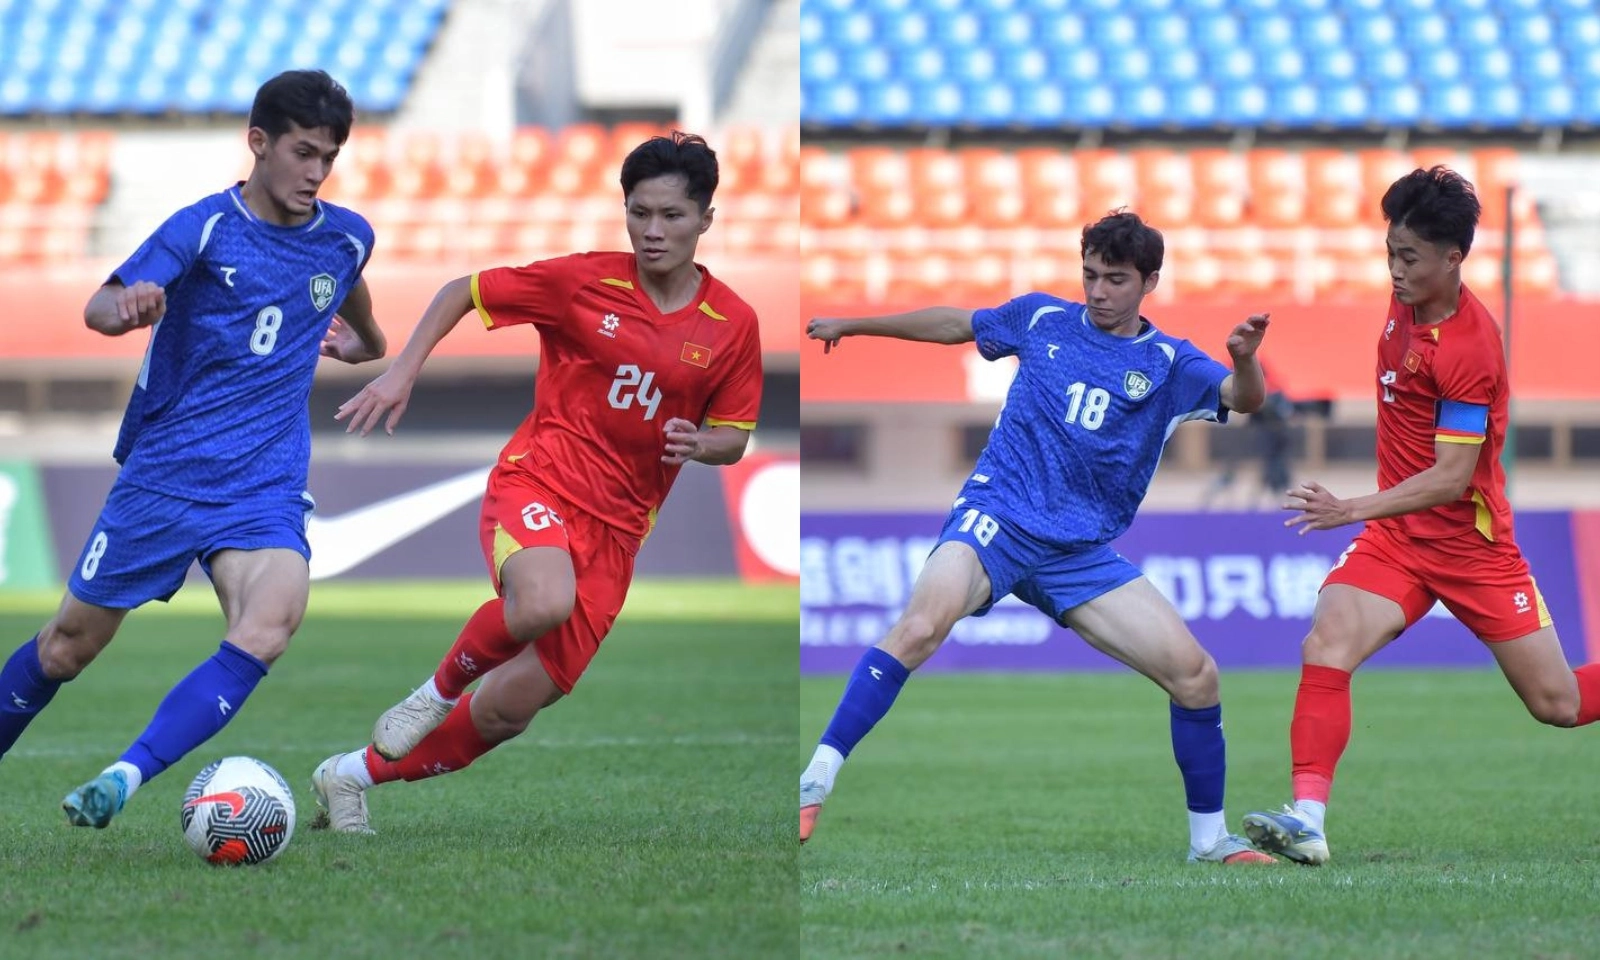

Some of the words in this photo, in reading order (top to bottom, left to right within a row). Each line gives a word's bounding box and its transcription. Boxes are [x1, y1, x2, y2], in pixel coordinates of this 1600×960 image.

[314, 279, 332, 295] UFA
[250, 305, 283, 356] 8
[607, 364, 663, 421] 24
[1064, 381, 1110, 431] 18
[1128, 373, 1147, 391] UFA
[958, 508, 999, 548] 18
[81, 531, 108, 581] 8
